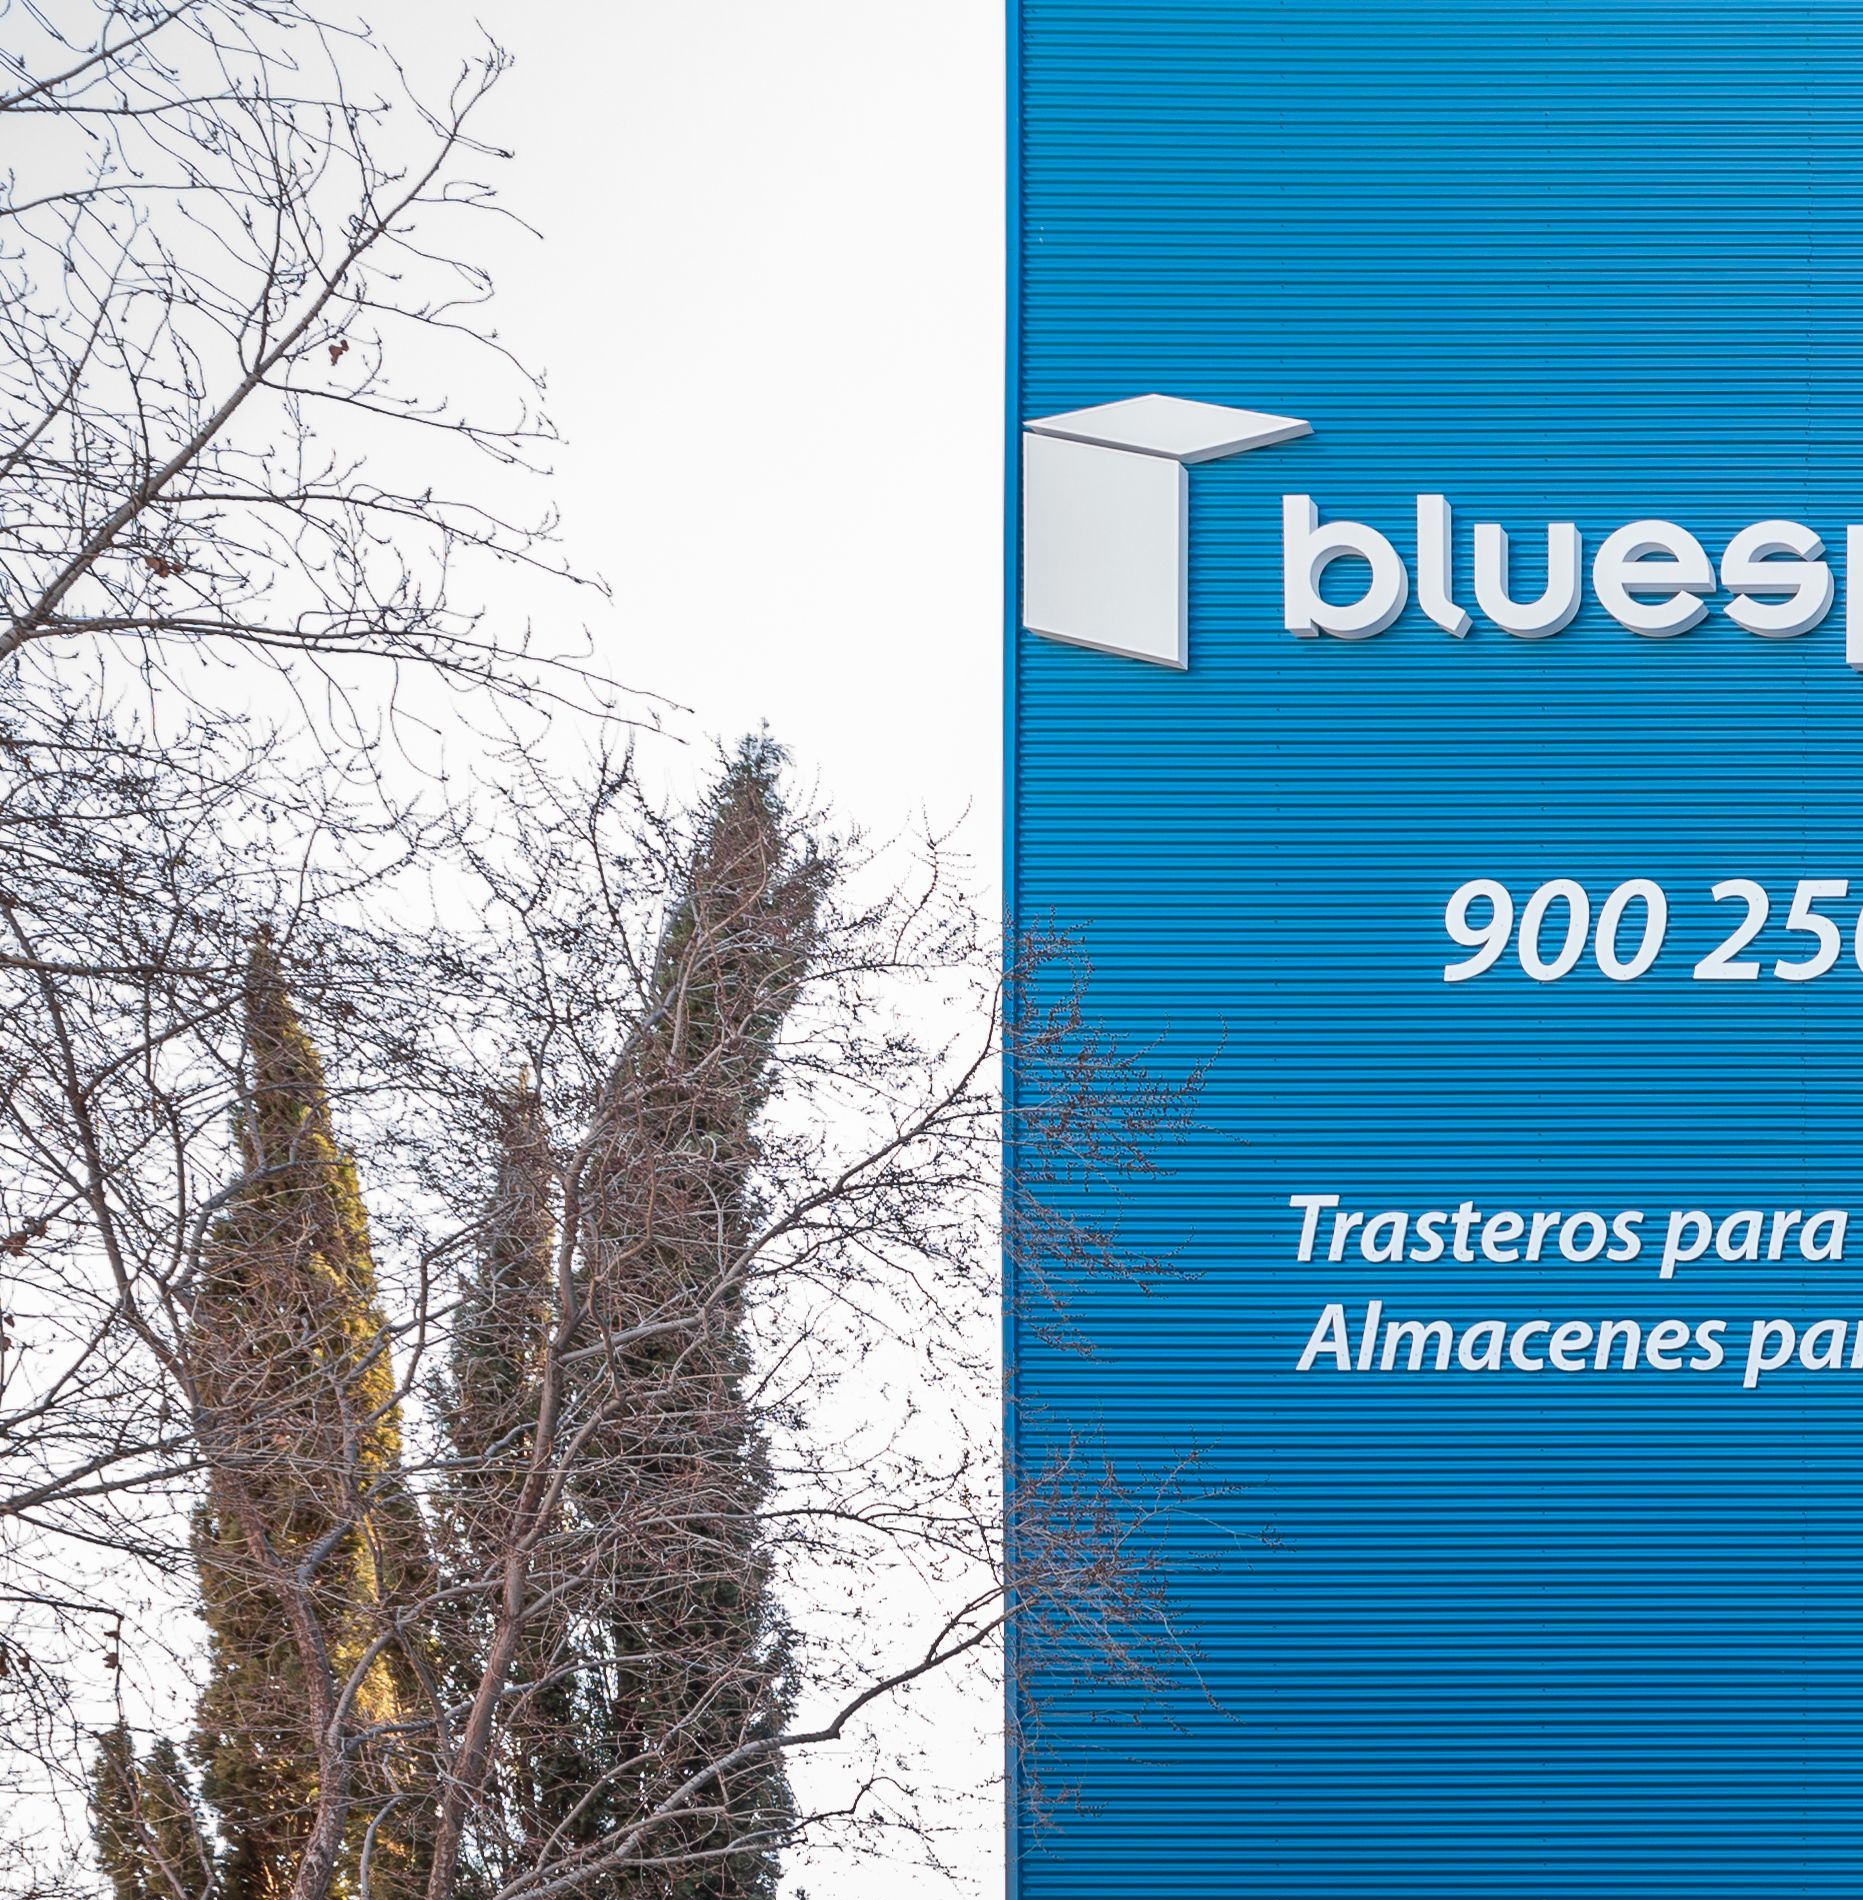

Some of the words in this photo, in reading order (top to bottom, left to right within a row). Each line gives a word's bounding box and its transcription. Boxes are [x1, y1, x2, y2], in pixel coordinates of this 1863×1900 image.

[1443, 878, 1667, 982] 900
[1289, 1194, 1644, 1263] Trasteros
[1659, 1209, 1848, 1279] para
[1295, 1300, 1727, 1371] Almacenes
